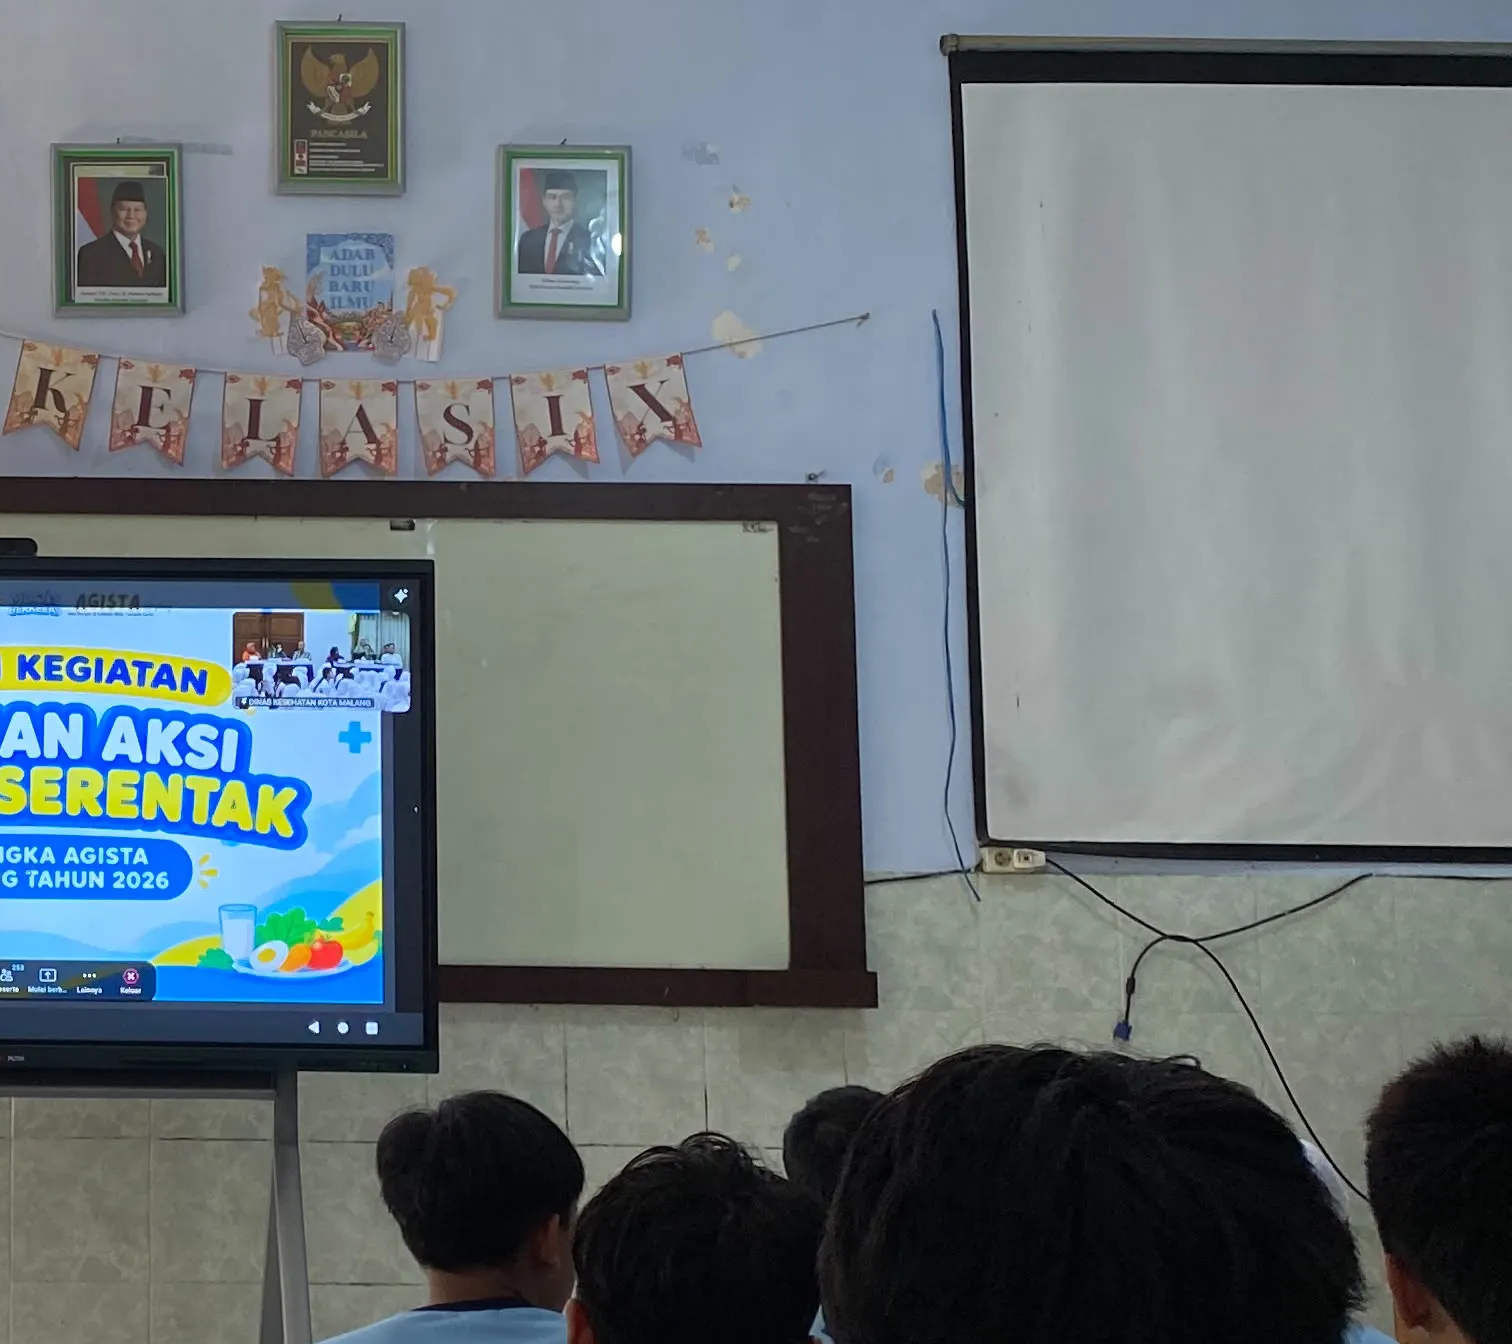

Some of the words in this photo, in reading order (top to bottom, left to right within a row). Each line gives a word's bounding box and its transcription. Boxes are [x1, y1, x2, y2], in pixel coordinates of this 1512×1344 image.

[310, 130, 368, 139] PANCASILA
[329, 248, 375, 260] ADAB
[329, 264, 374, 277] DULU
[328, 280, 375, 293] BARU
[329, 296, 373, 309] ILMU
[75, 593, 141, 610] AGISTA
[17, 654, 209, 696] KEGIATAN
[318, 699, 338, 707] KOTA
[101, 715, 239, 773] AKSI
[63, 846, 149, 866] AGISTA
[24, 869, 107, 889] TAHUN
[112, 870, 170, 891] 2026
